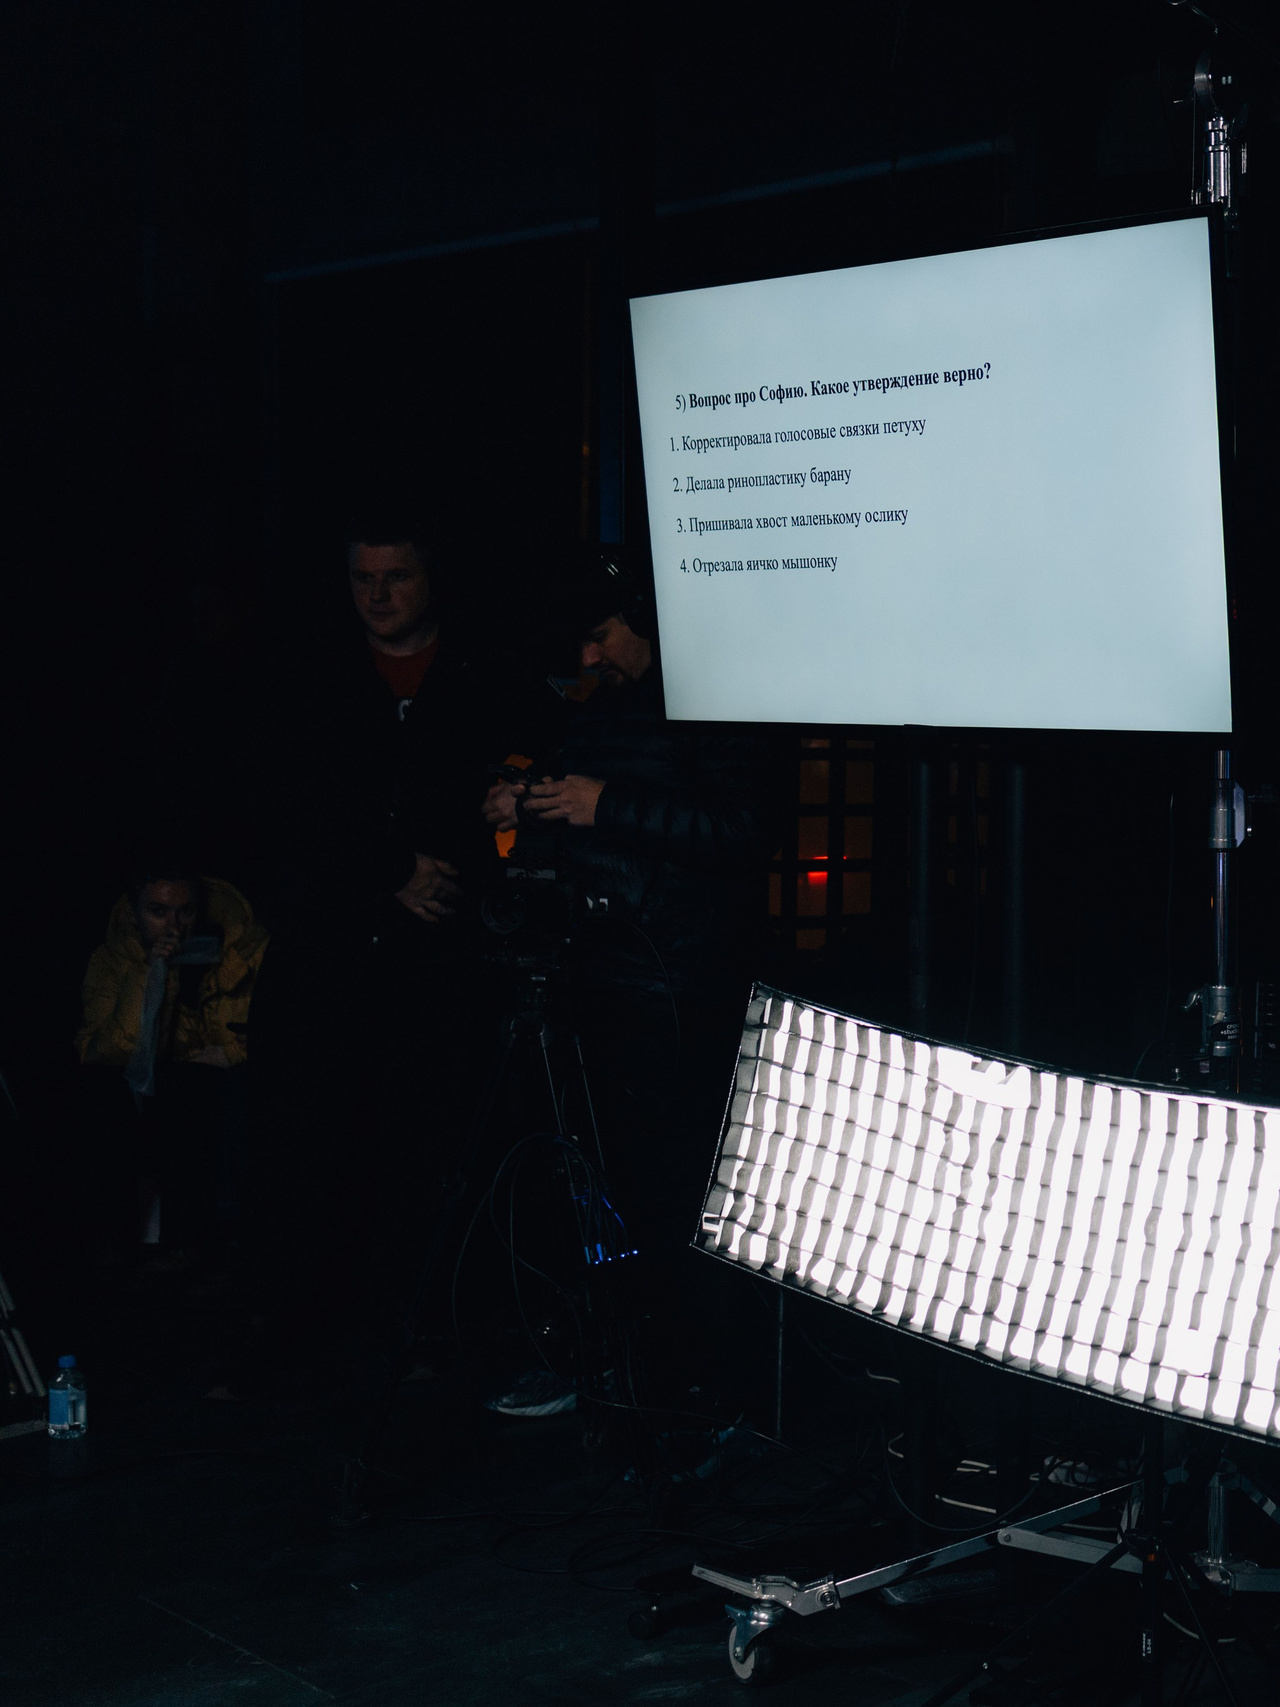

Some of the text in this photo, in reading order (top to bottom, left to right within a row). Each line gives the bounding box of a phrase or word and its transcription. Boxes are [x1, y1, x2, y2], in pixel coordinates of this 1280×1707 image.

[675, 361, 992, 414] 5) Вопрос про Софию. Какое утверждение верно?
[670, 418, 927, 455] 1. Корректировала голосовые связки петуху
[672, 466, 852, 495] 2. Делала ринопластику барану
[676, 509, 909, 537] 3. Пришивала хвост маленькому ослику
[679, 556, 838, 577] 4. Отрезала яичко мышонку
